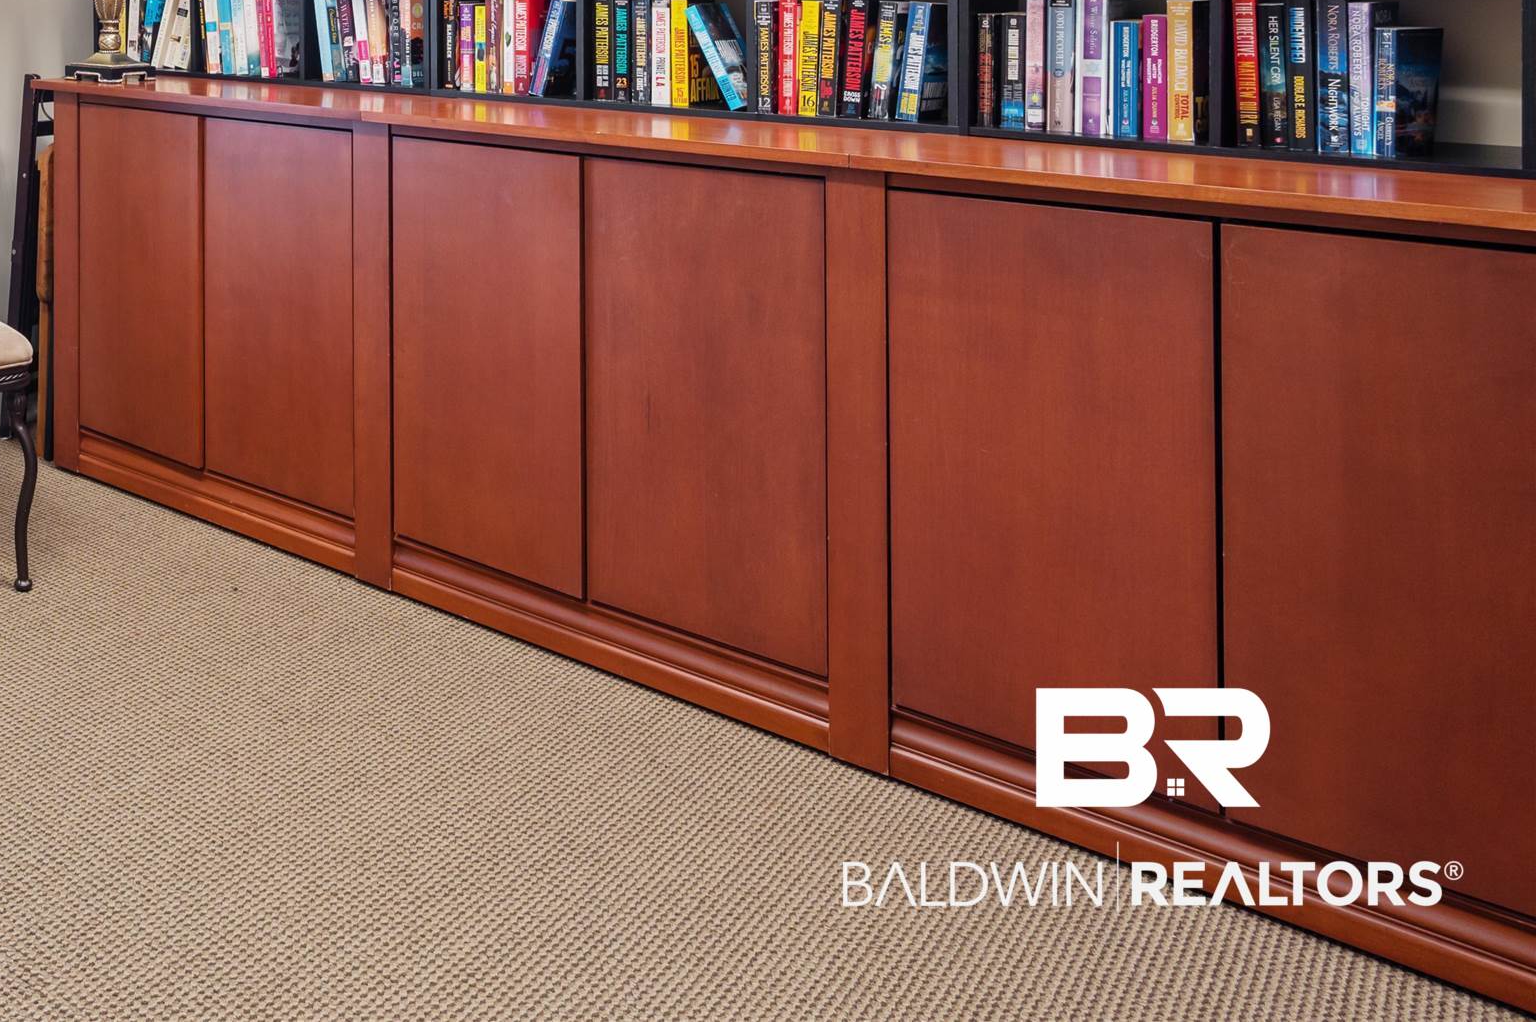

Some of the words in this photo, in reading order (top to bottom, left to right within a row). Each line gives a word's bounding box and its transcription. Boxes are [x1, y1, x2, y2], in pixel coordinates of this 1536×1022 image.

[340, 4, 350, 34] WATER
[516, 1, 527, 20] JAMES
[595, 2, 608, 25] JAMES
[615, 8, 627, 30] JAMES
[656, 10, 665, 26] JAMES
[1054, 10, 1065, 30] JODI
[1089, 6, 1098, 28] Winter
[1235, 2, 1254, 15] THE
[1327, 5, 1340, 31] NORA
[516, 20, 526, 50] PATTERSON
[824, 11, 837, 36] JAMES
[849, 9, 864, 39] JAMES
[1268, 16, 1278, 33] HER
[1290, 7, 1305, 64] UNIDENTIFIED
[1351, 10, 1361, 35] NORA
[595, 27, 609, 64] PATTERSON
[655, 28, 665, 53] PATTERSON
[675, 27, 686, 48] JAMES
[760, 27, 768, 51] JAMES
[802, 31, 817, 54] JAMES
[907, 33, 922, 54] JAMES
[1054, 31, 1065, 67] PICOULT
[1122, 26, 1130, 57] BRIDGERTON
[1150, 19, 1159, 56] BRIDGERTON
[1235, 18, 1255, 57] DIRECTIVE
[1269, 35, 1279, 64] SILENT
[615, 34, 627, 74] PATTERSON
[821, 38, 835, 79] PATTERSON
[1328, 33, 1339, 70] ROBERTS
[1352, 40, 1362, 81] ROBERTS
[515, 55, 526, 78] INVISIBLE
[656, 57, 665, 75] PRIVATE
[676, 49, 686, 84] PATTERSON
[760, 52, 769, 96] PATTERSON
[800, 55, 816, 92] PATTERSON
[845, 41, 862, 91] PATTERSON
[903, 54, 919, 89] PATTERSON
[1270, 67, 1281, 84] CRY
[1386, 64, 1394, 86] NORA
[1238, 61, 1256, 98] MATTHEW
[1294, 76, 1305, 102] DOUGLAS
[1180, 94, 1189, 120] TOTAL
[1239, 102, 1258, 124] QUIRK
[1273, 97, 1281, 109] LISA
[1325, 78, 1340, 131] NIGHTWORK
[1361, 97, 1370, 132] TONIGHT
[1273, 110, 1282, 131] REGAN
[1353, 106, 1362, 137] ALWAYS
[1376, 120, 1385, 141] ANGEL
